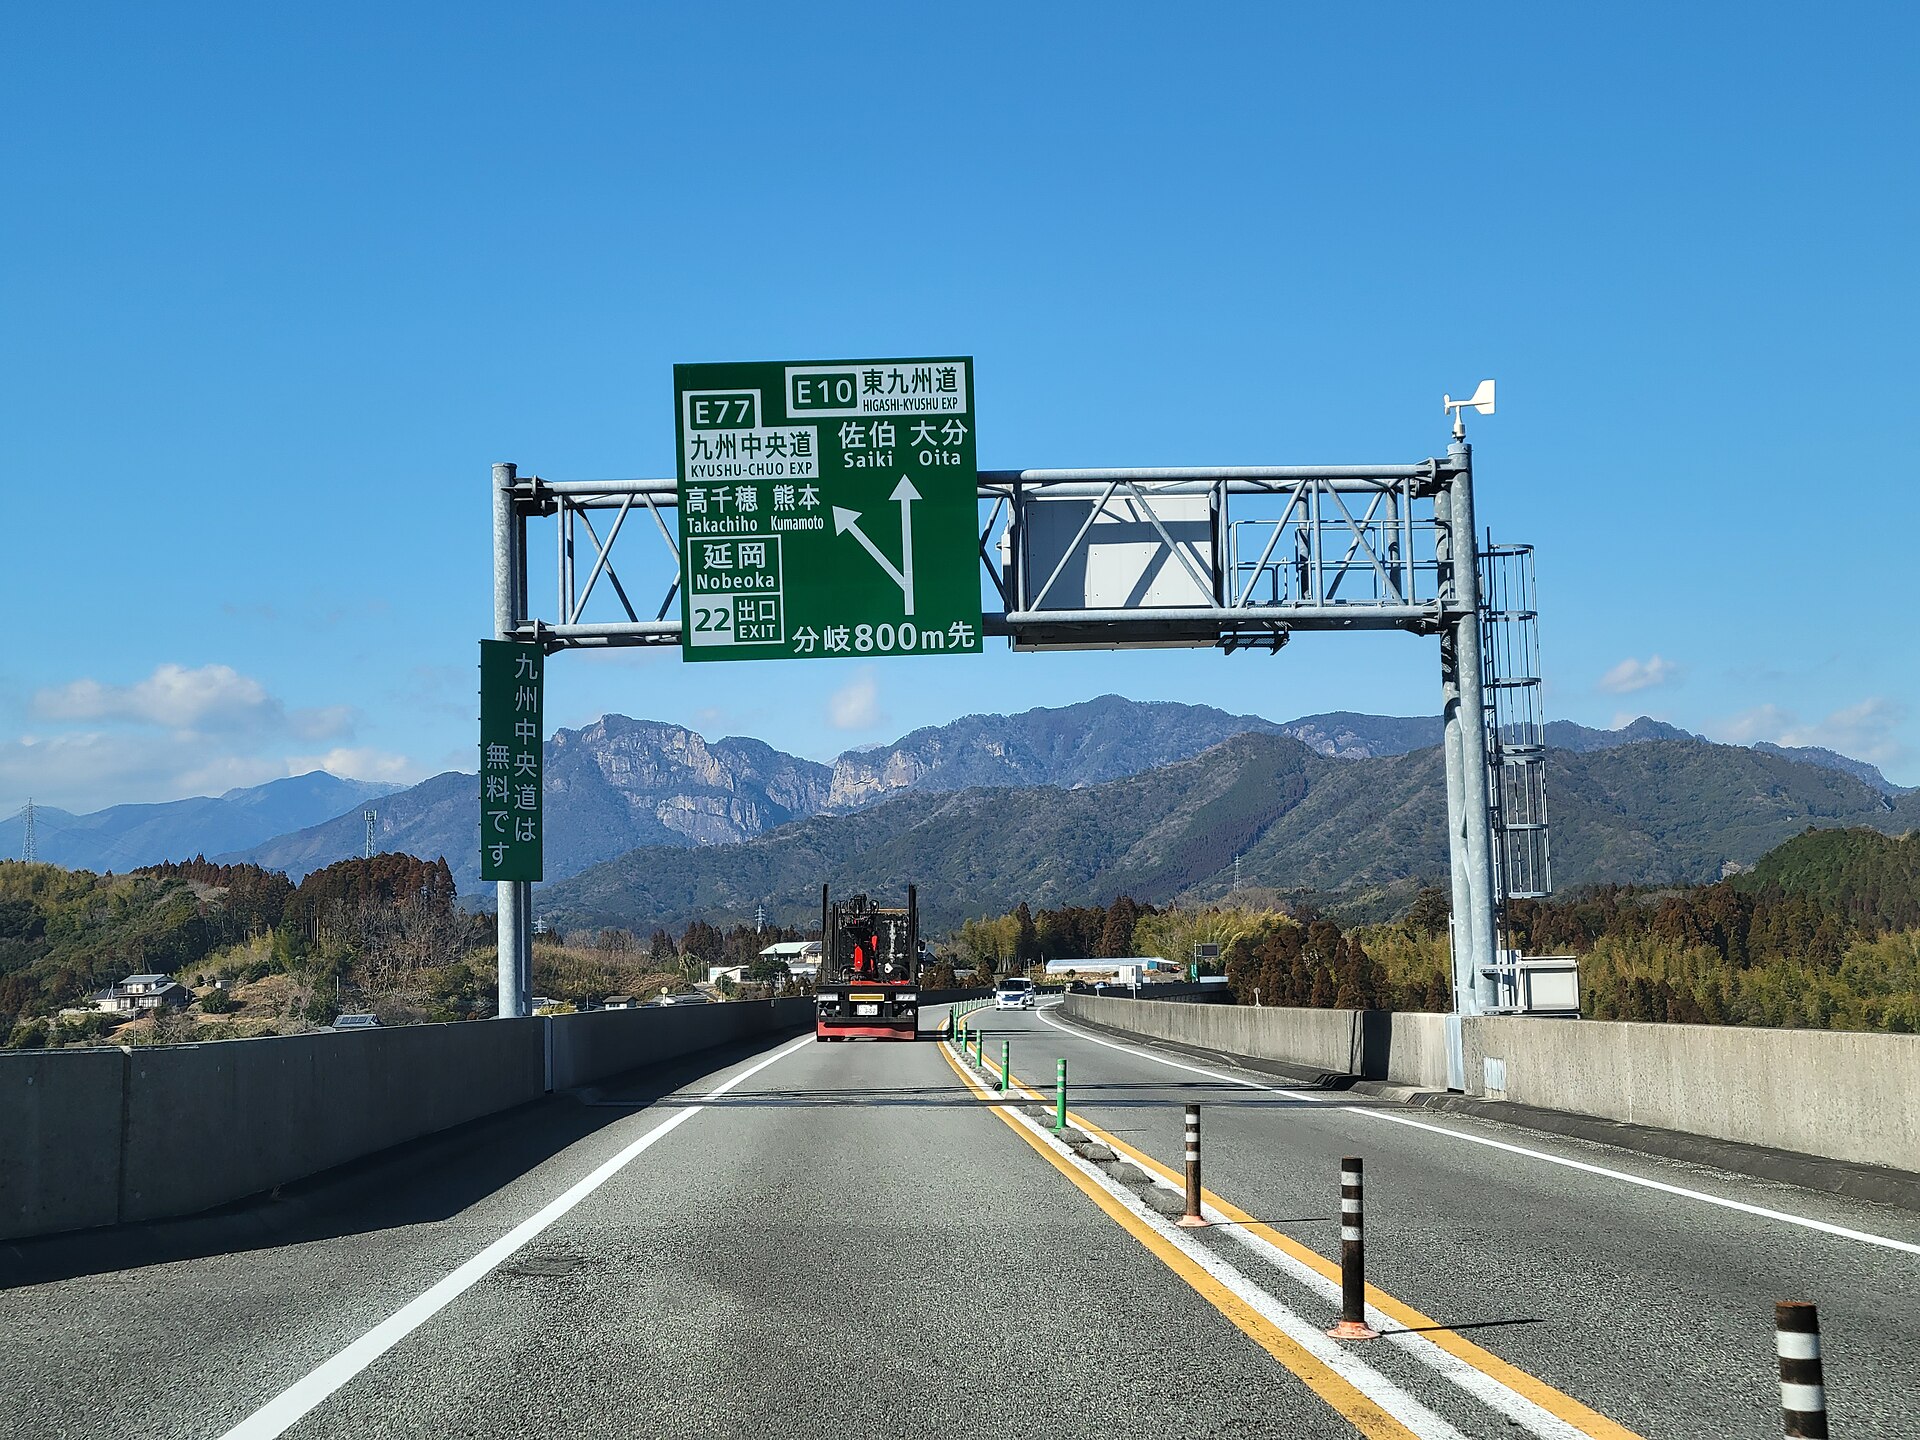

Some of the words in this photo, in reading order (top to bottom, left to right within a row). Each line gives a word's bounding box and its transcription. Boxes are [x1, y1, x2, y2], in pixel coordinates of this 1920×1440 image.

[797, 379, 852, 404] E10
[862, 366, 959, 396] 東九州道
[695, 400, 750, 424] E77
[863, 398, 939, 412] HIGASHI-KYUSHU
[941, 397, 958, 410] EXP
[690, 431, 813, 461] 九州中央道
[837, 420, 896, 450] 佐伯
[910, 418, 968, 447] 大分
[691, 463, 784, 478] KYUSHU-CHUO
[789, 461, 813, 475] EXP
[844, 450, 894, 468] Saiki
[919, 448, 961, 466] Oita
[685, 485, 759, 515] 高千穂
[772, 483, 821, 511] 熊本
[687, 516, 758, 534] Takachiho
[770, 515, 824, 531] Kumamoto
[703, 542, 766, 570] 延岡
[696, 571, 775, 590] Nobeoka
[694, 607, 732, 633] 22
[738, 599, 776, 623] 出口
[739, 624, 776, 639] EXIT
[514, 652, 539, 842] 九州中央道は
[486, 741, 510, 868] 無料です
